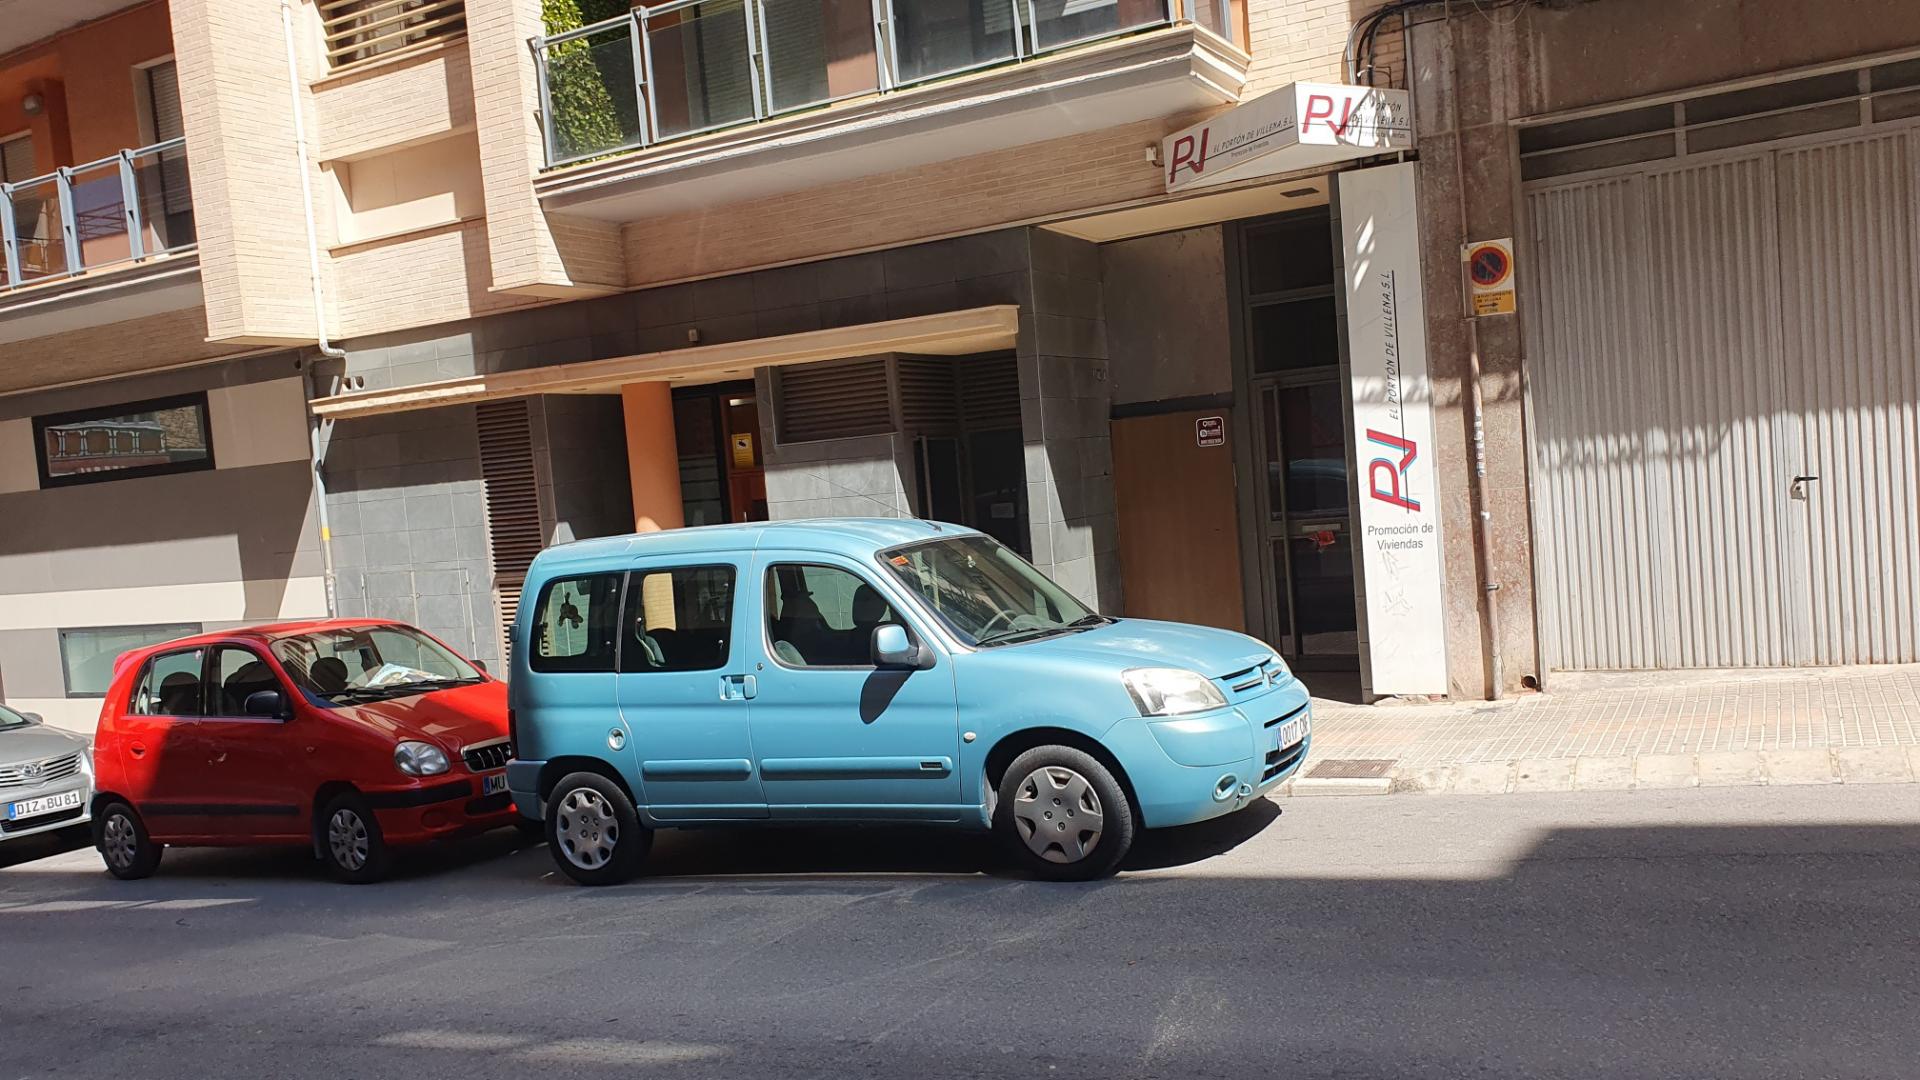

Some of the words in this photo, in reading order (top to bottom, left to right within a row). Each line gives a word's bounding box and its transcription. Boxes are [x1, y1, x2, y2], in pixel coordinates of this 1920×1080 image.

[1385, 341, 1394, 357] DE
[1389, 408, 1399, 420] EL
[1368, 523, 1419, 536] Promoción
[1421, 522, 1434, 534] de
[1377, 538, 1424, 551] Viviendas
[16, 800, 40, 815] DIZ
[46, 796, 62, 809] BU
[64, 792, 79, 805] 81
